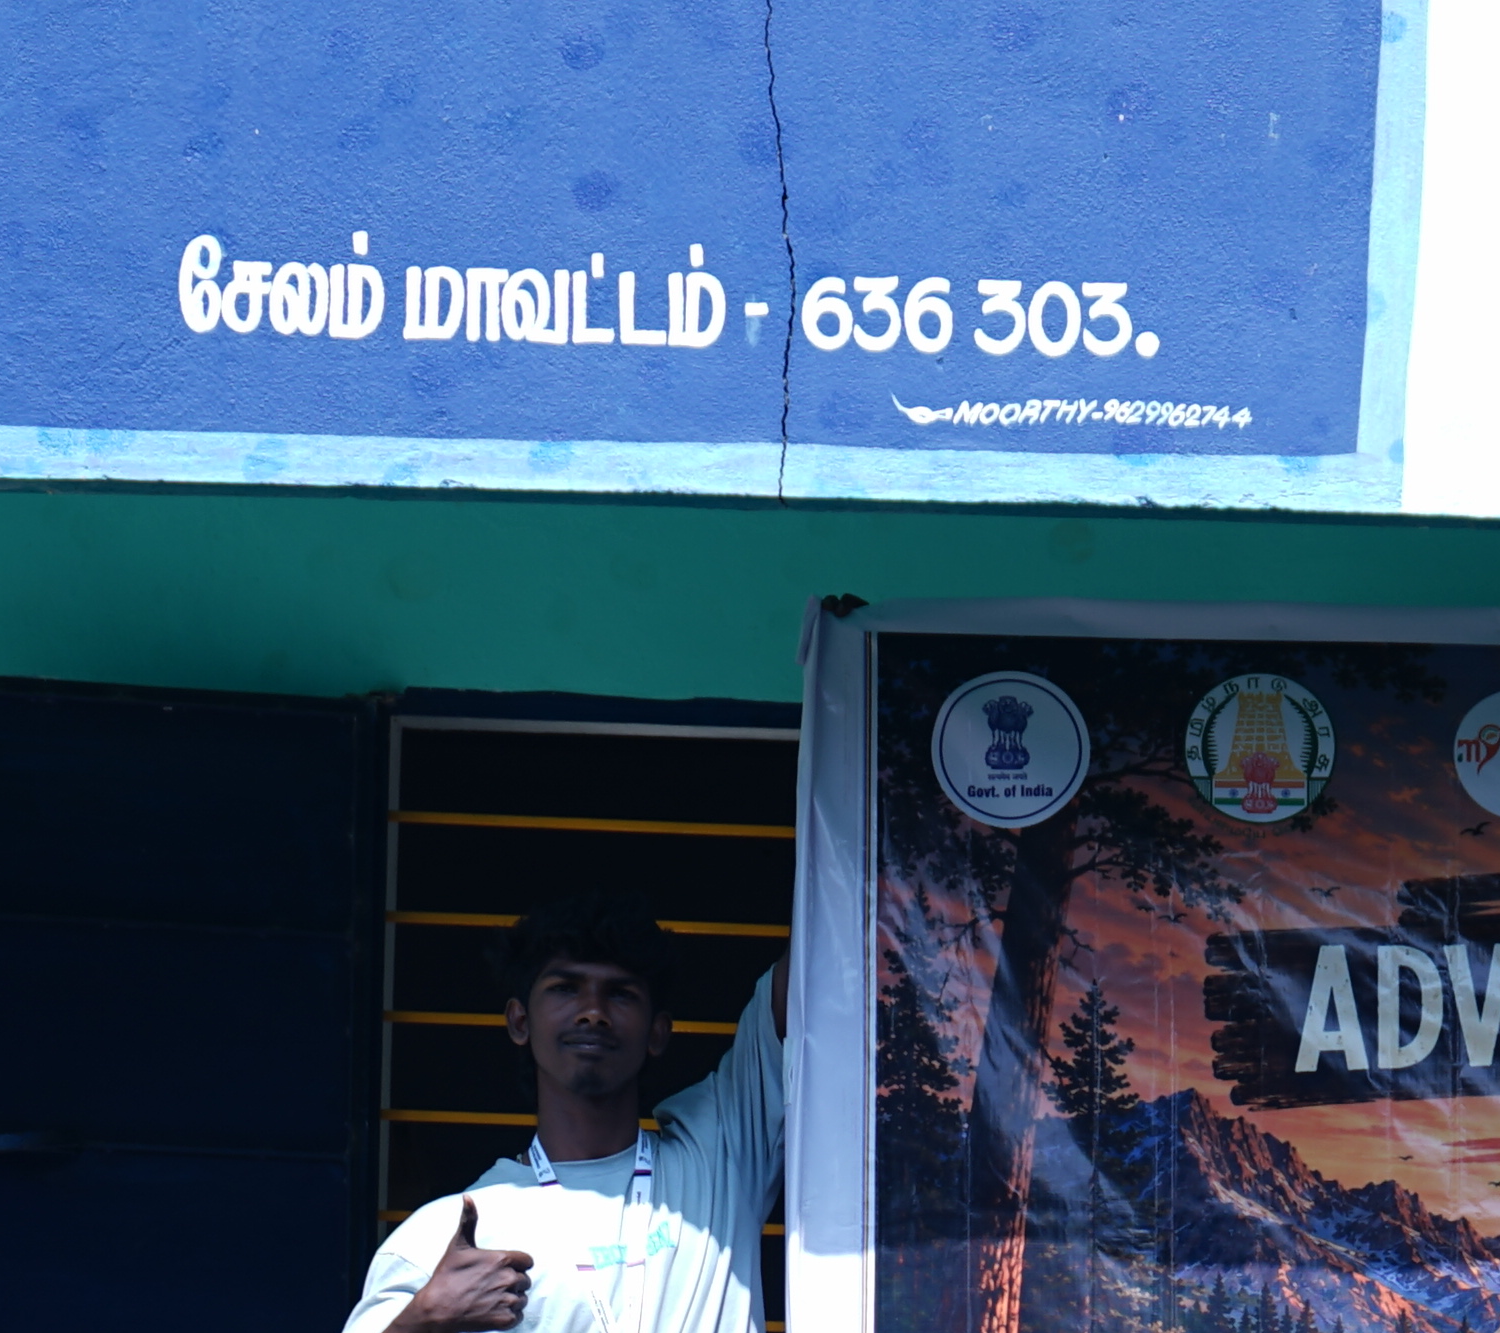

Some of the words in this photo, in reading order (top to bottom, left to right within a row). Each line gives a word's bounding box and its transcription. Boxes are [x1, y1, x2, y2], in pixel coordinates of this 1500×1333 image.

[178, 230, 385, 340] சேலம்
[404, 243, 726, 349] மாவட்டம்
[800, 272, 953, 354] 636
[975, 276, 1161, 359] 303.
[967, 784, 1001, 798] Govt.
[1004, 784, 1016, 798] of
[1020, 784, 1053, 798] India
